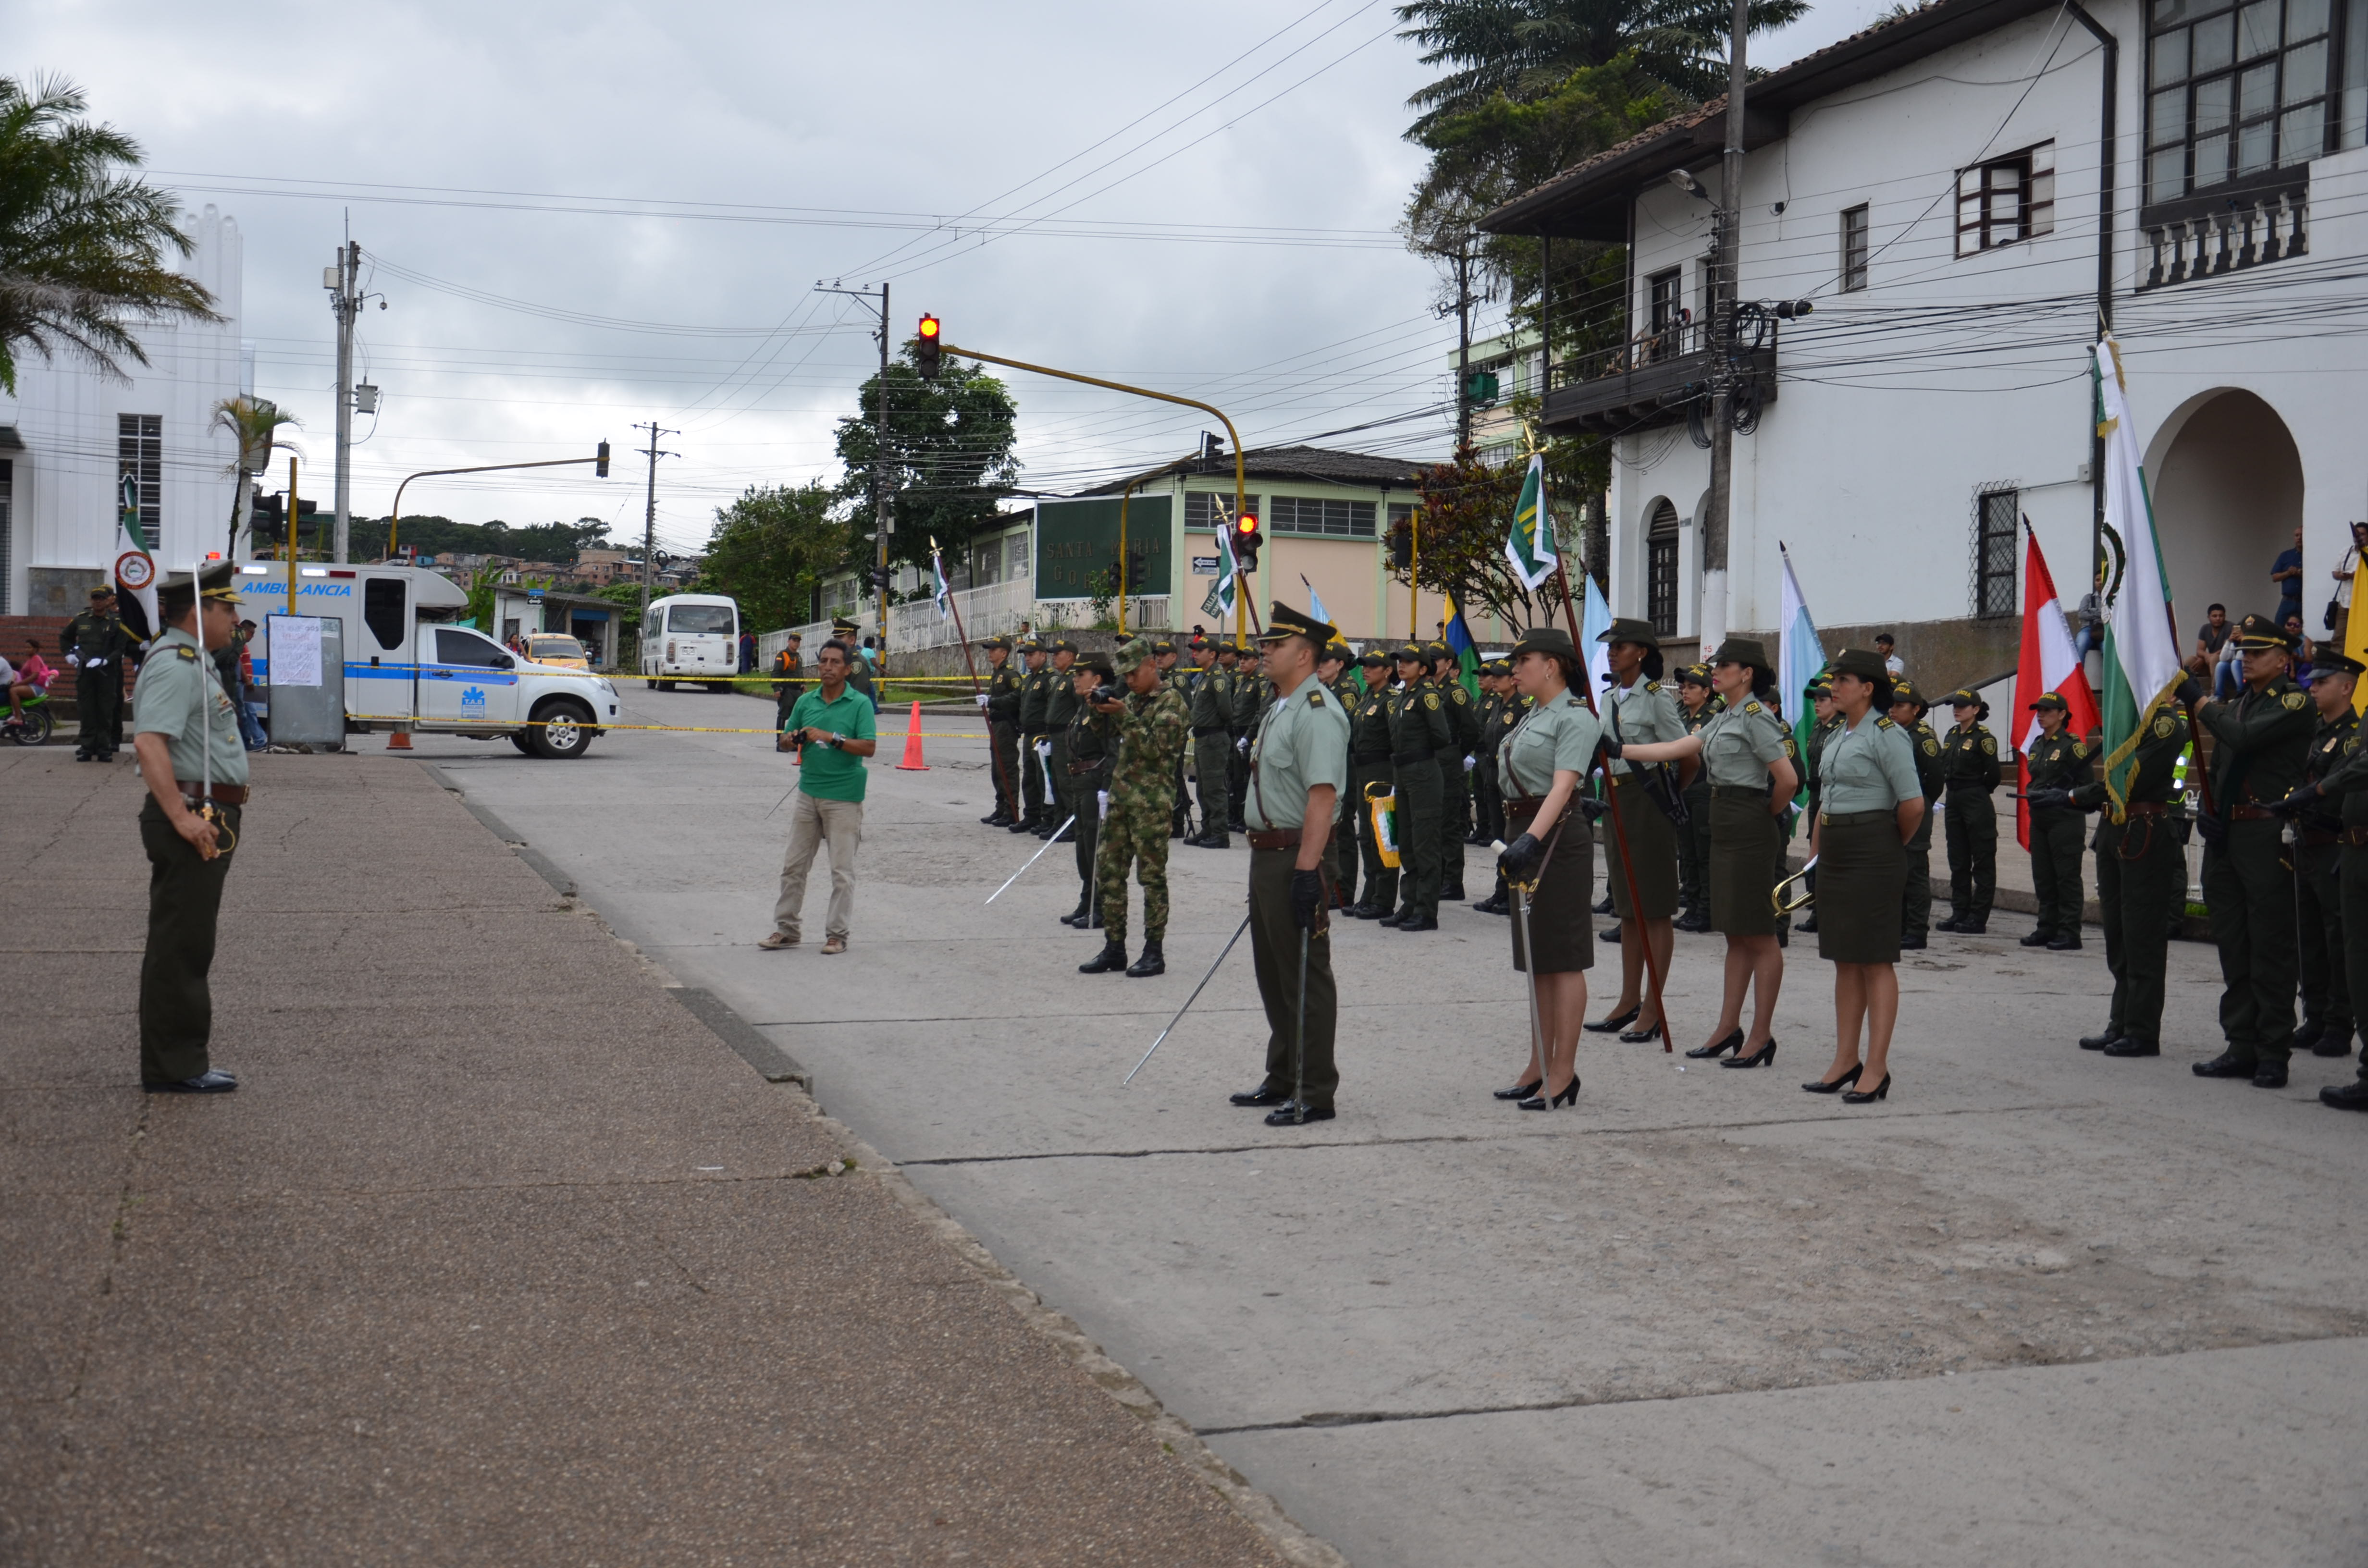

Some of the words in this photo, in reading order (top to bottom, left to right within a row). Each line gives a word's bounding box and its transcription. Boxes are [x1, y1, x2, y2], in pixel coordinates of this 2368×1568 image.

[1047, 541, 1093, 559] SANTA
[1110, 537, 1161, 556] MRIA
[241, 582, 351, 597] AMBULANCIA
[1203, 592, 1218, 611] CALLE
